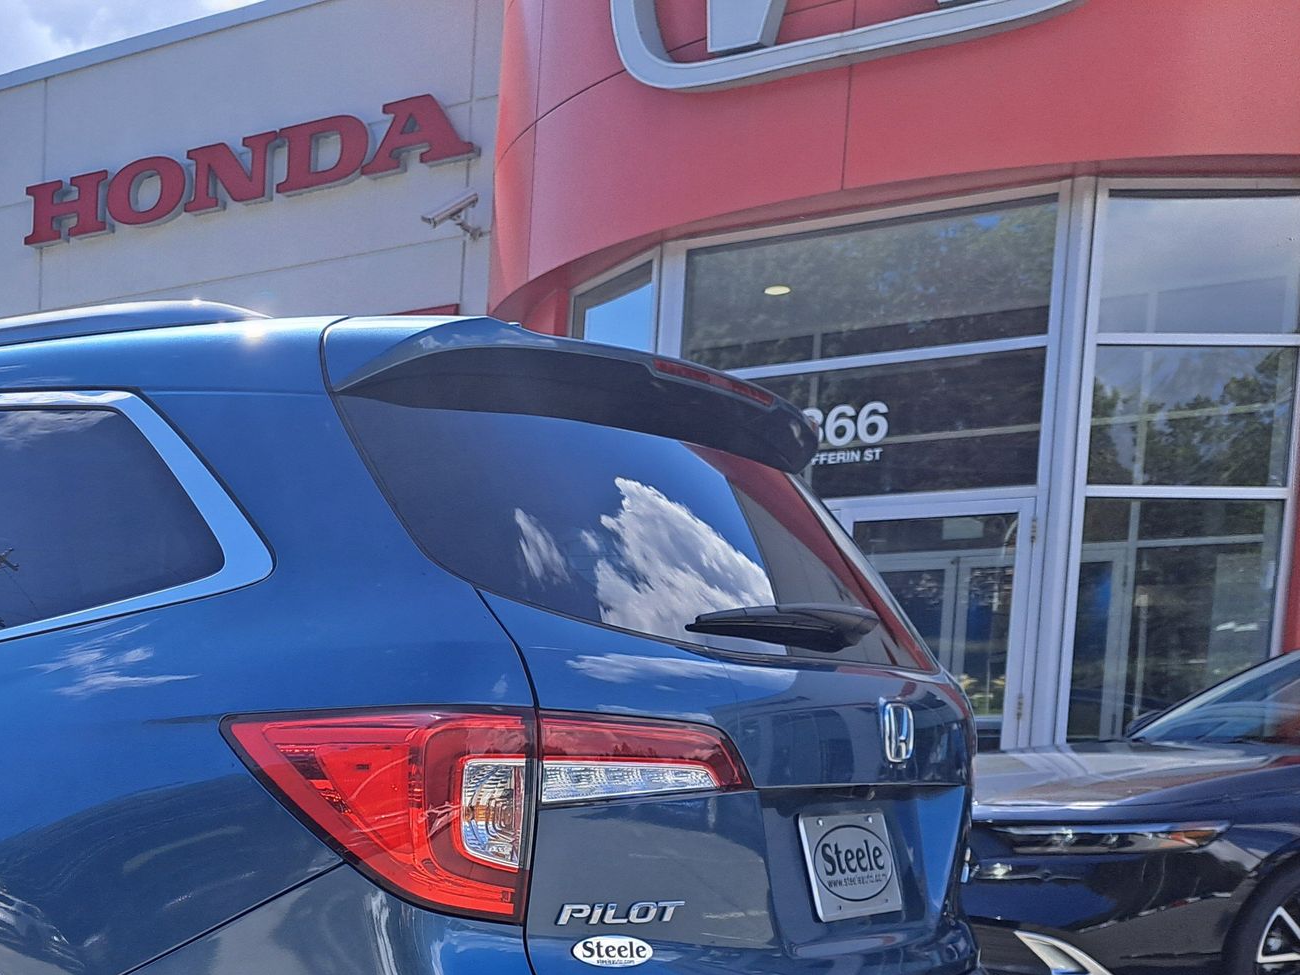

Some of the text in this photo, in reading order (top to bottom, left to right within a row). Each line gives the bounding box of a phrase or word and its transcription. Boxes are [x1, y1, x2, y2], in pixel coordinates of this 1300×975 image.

[23, 93, 479, 247] HONDA
[811, 448, 883, 465] FFERIN ST
[821, 839, 885, 876] Steele
[555, 900, 686, 926] PILOT
[582, 940, 647, 958] Steele
